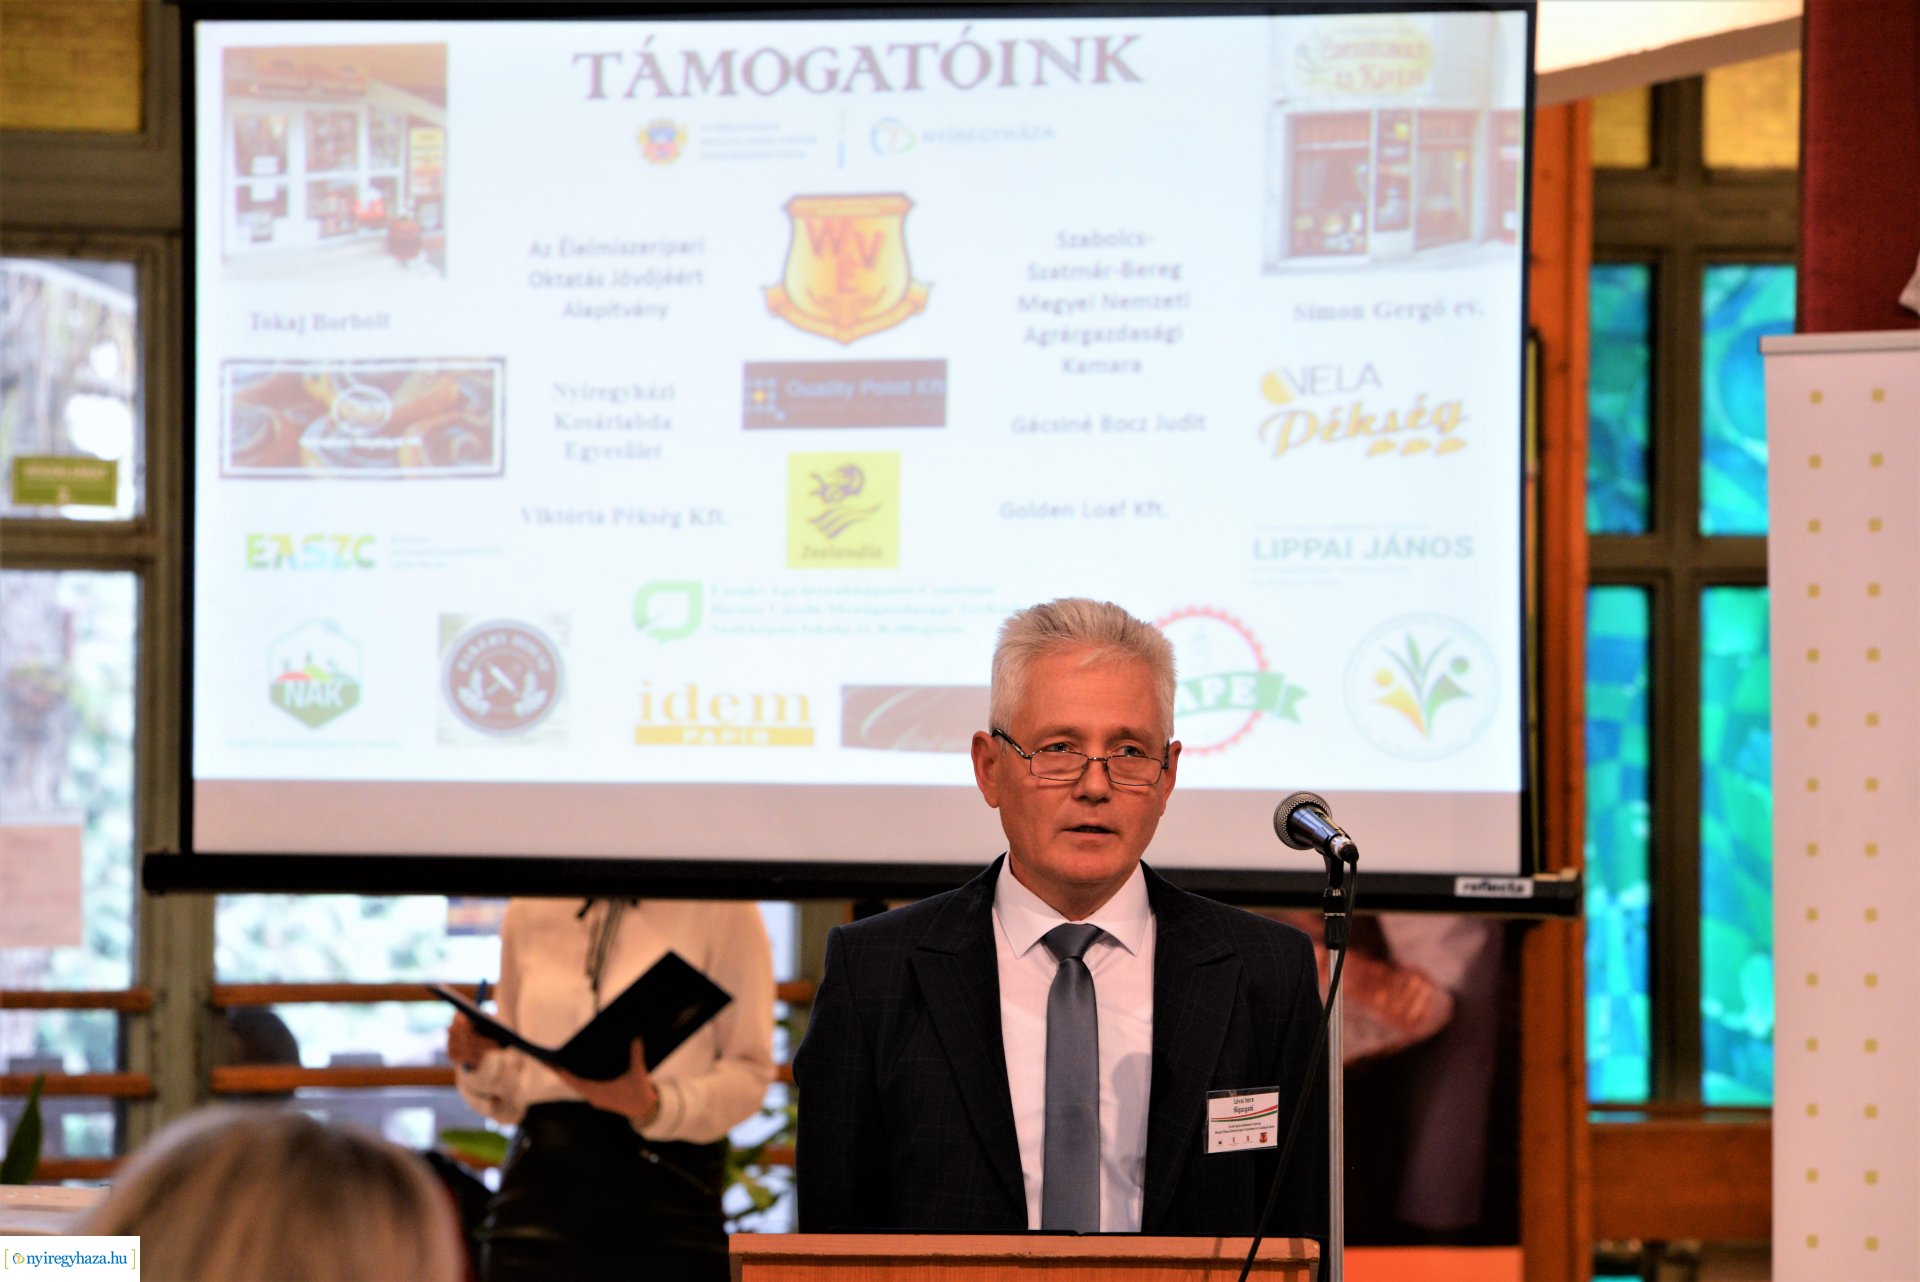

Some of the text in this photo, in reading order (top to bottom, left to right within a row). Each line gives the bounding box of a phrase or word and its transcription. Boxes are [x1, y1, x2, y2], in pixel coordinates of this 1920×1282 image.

[572, 26, 1143, 99] TÁMOGATÓINK
[528, 235, 706, 261] Az Élelmiszeripari
[1055, 230, 1156, 250] Szabolcs-
[527, 265, 704, 291] Oktatás Jövőjéért
[1025, 259, 1183, 283] Szatmár-Bereg
[561, 299, 671, 323] Alapítvány
[1016, 291, 1191, 317] Megyei Nemzeti
[1293, 304, 1363, 321] Simon
[249, 312, 305, 335] Tokaj
[1022, 322, 1184, 348] Agrárgazdasági
[1060, 356, 1143, 375] Kamara
[1282, 362, 1382, 396] VELA
[554, 412, 673, 432] Kosárlabda
[1154, 410, 1207, 432] Judit
[520, 506, 606, 527] Viktória
[611, 505, 682, 531] Pékség
[998, 500, 1074, 519] Golden
[1082, 498, 1126, 519] Loaf
[1252, 530, 1475, 561] LIPPAI JÁNOS
[283, 677, 345, 706] NAK
[637, 681, 812, 725] idem
